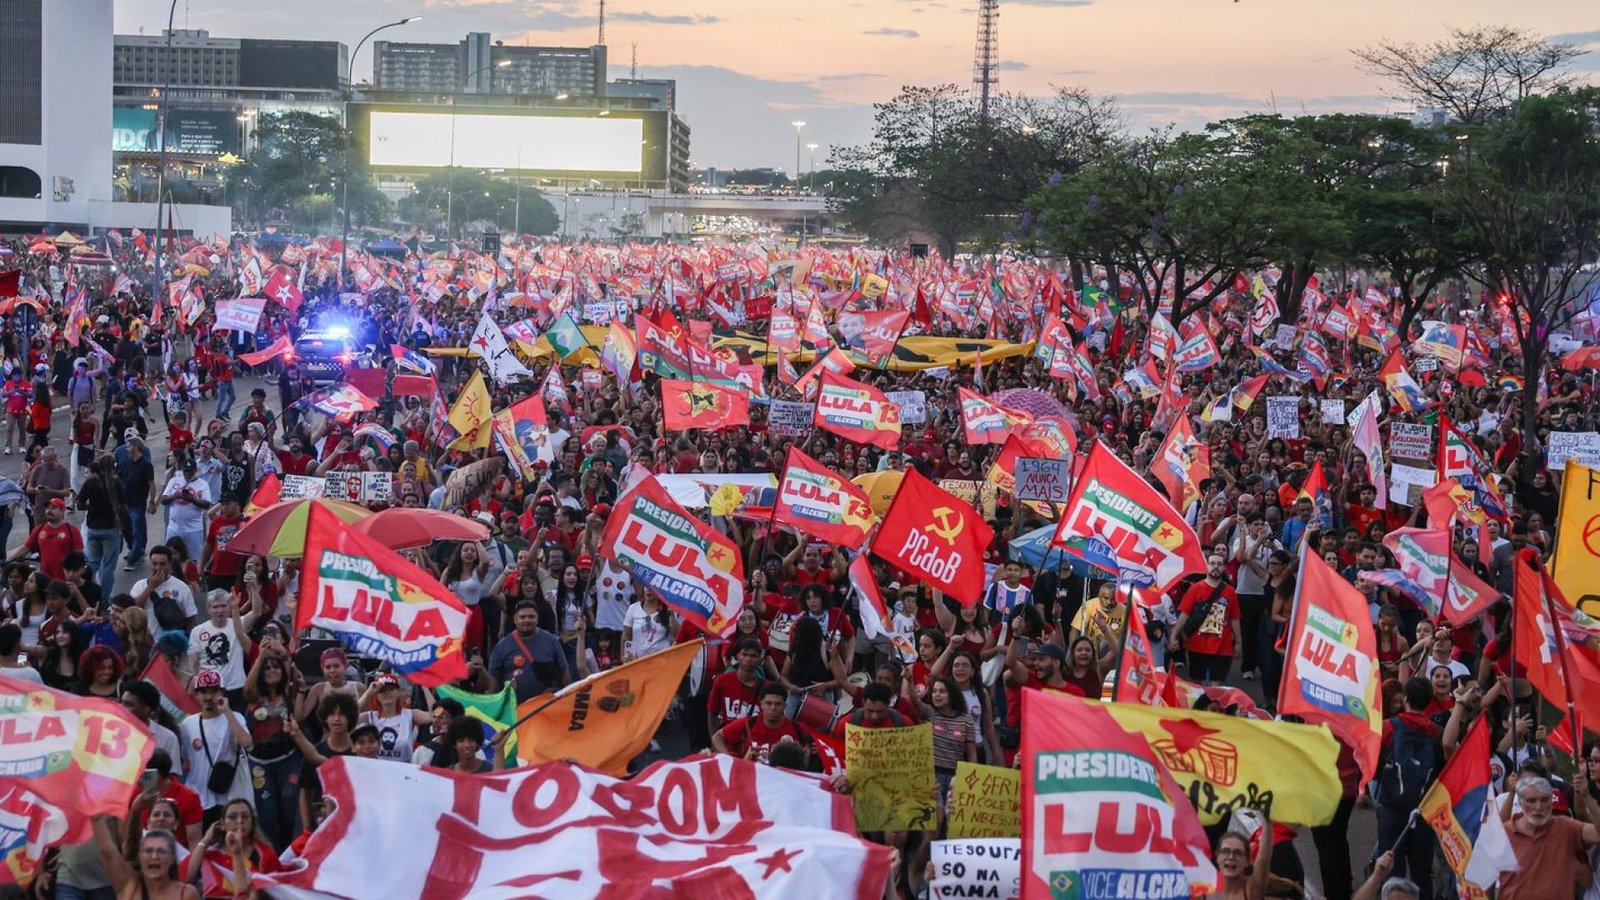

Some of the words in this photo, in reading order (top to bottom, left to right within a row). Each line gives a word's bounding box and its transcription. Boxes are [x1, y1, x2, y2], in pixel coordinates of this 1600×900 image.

[820, 396, 873, 415] LULA
[880, 403, 900, 424] 13
[1021, 461, 1060, 474] 1964
[1026, 473, 1060, 485] NUNCA
[784, 479, 841, 506] LULA
[1018, 483, 1064, 499] MAIS
[848, 500, 873, 521] 13
[622, 520, 730, 607] LULA
[898, 527, 962, 584] PCdoB
[319, 585, 450, 642] LULA
[1301, 631, 1359, 684] LULA
[84, 715, 131, 760] 13
[976, 869, 1000, 881] NA
